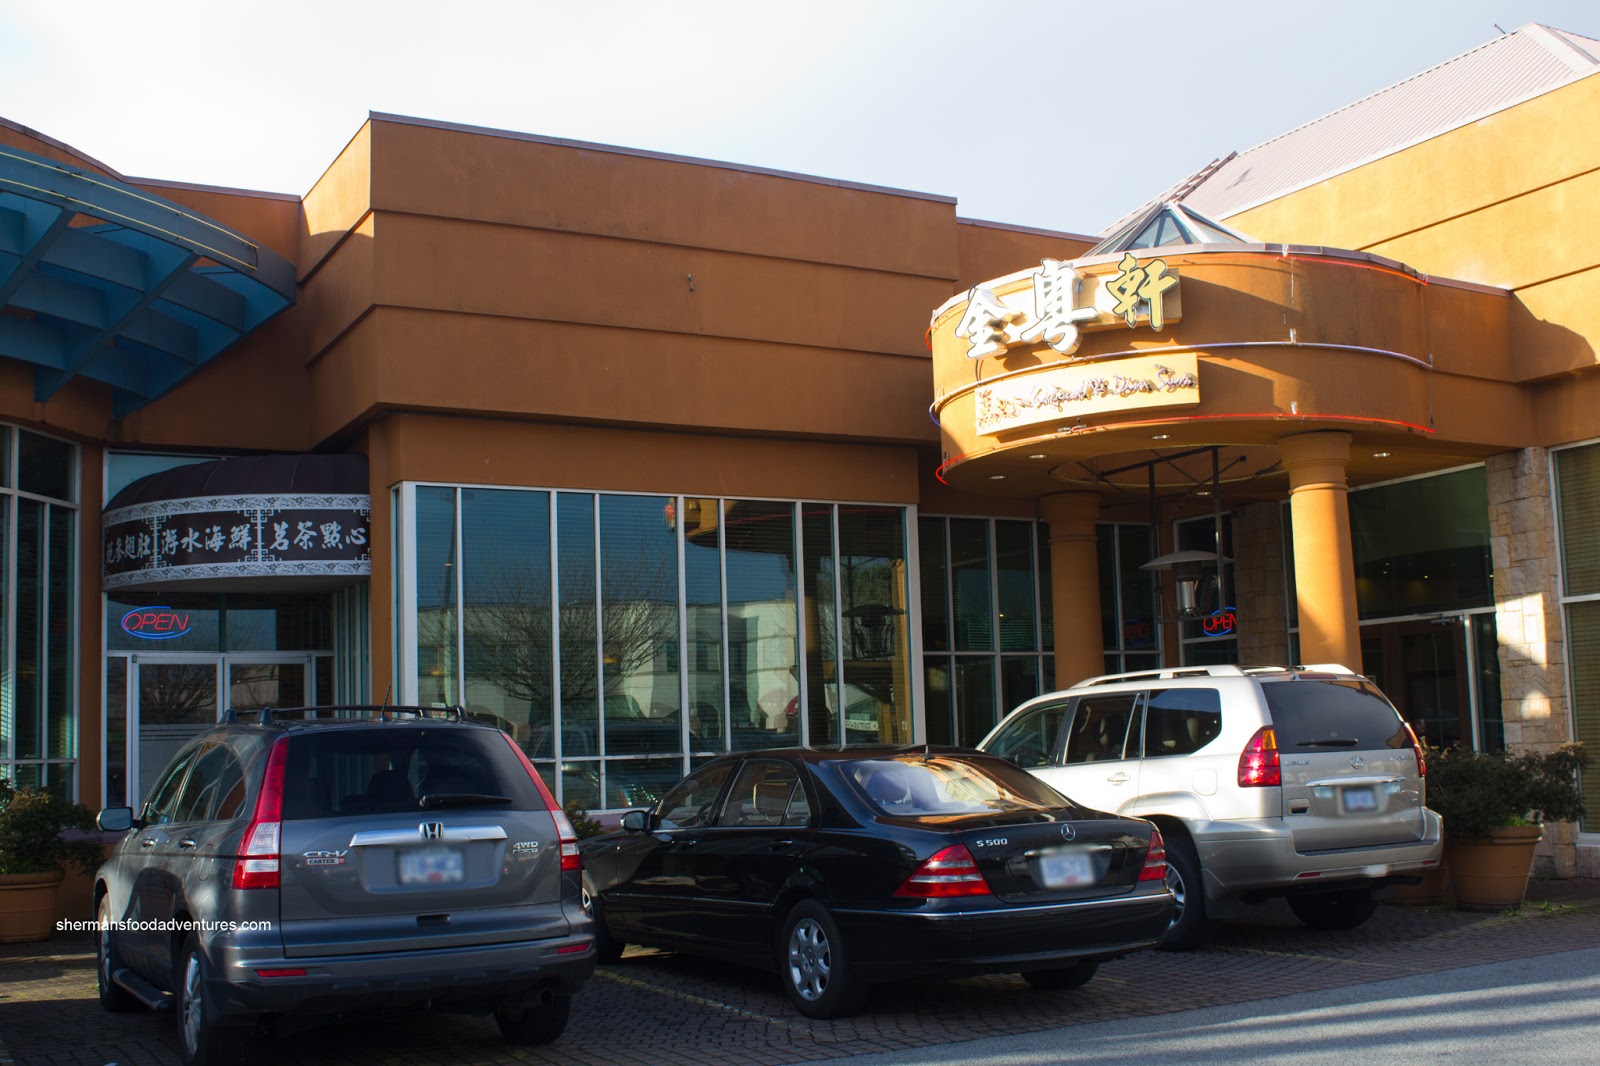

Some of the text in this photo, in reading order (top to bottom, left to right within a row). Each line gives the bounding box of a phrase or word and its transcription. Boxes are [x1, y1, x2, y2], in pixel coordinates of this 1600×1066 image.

[123, 613, 189, 631] OPEN
[512, 841, 539, 849] 4WD
[976, 838, 1008, 848] S 500
[302, 849, 349, 858] CR-V
